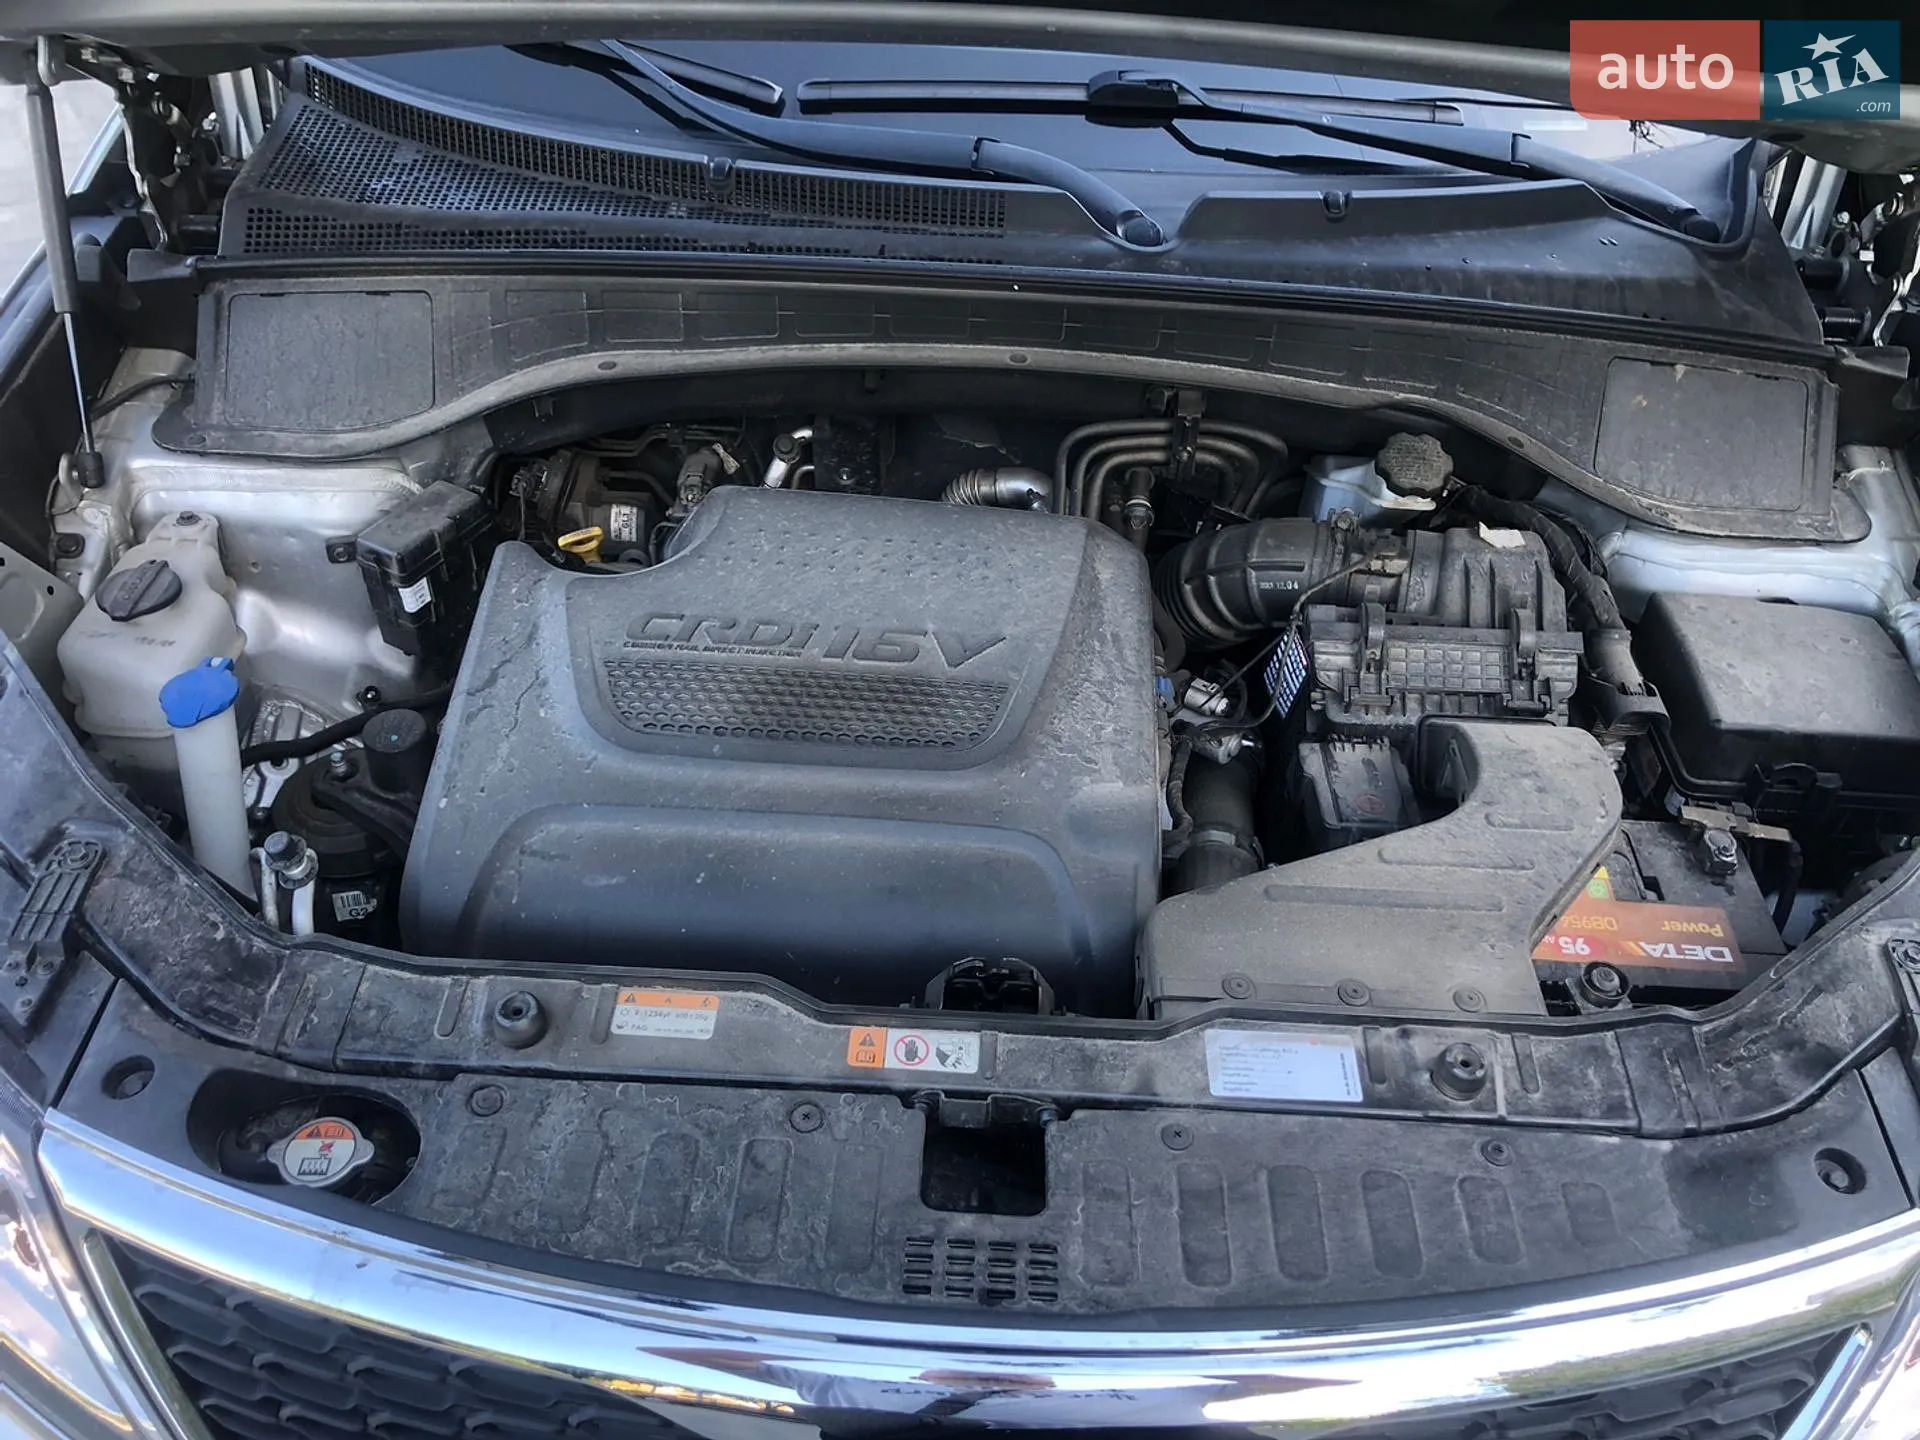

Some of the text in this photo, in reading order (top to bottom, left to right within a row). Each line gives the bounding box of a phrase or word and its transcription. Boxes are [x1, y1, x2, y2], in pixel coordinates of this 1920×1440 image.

[1660, 919, 1725, 938] Power
[1558, 935, 1592, 956] 95
[1637, 940, 1734, 963] DETA
